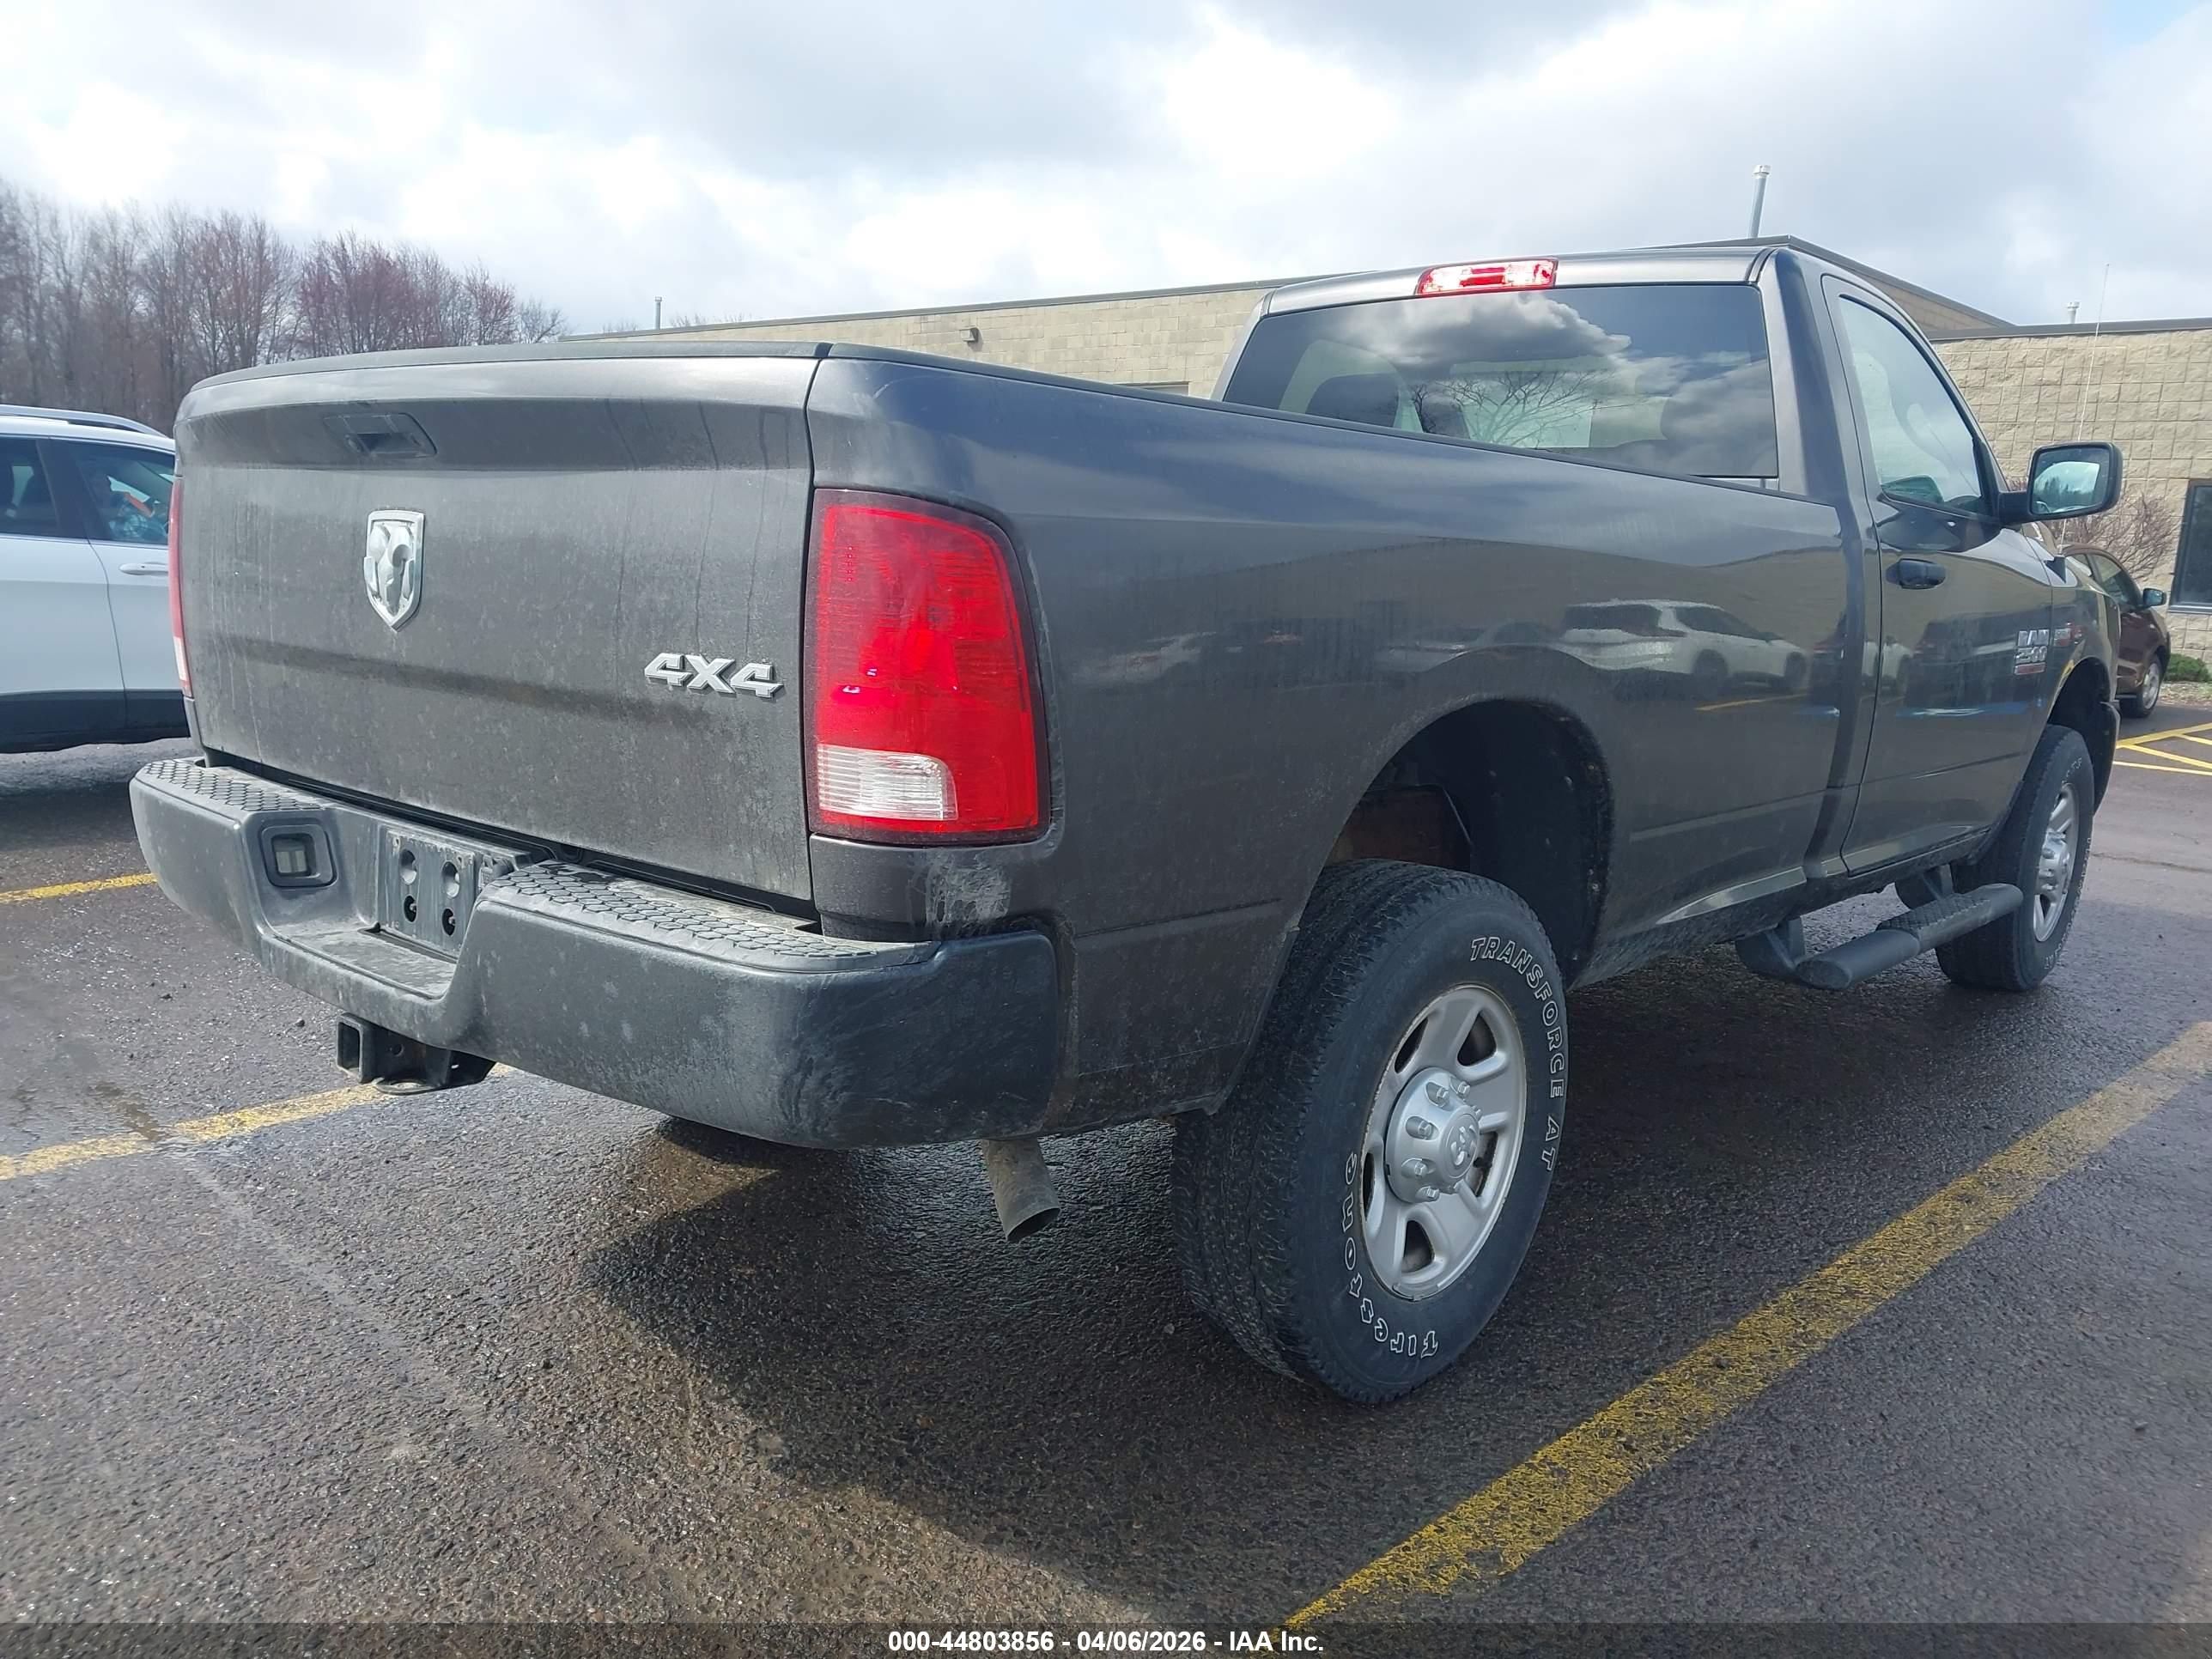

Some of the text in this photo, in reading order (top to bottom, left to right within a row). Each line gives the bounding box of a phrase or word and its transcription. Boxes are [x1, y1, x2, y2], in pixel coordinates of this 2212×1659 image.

[2017, 629, 2050, 647] RAM
[1470, 936, 1565, 1171] TRANSFORCE AT
